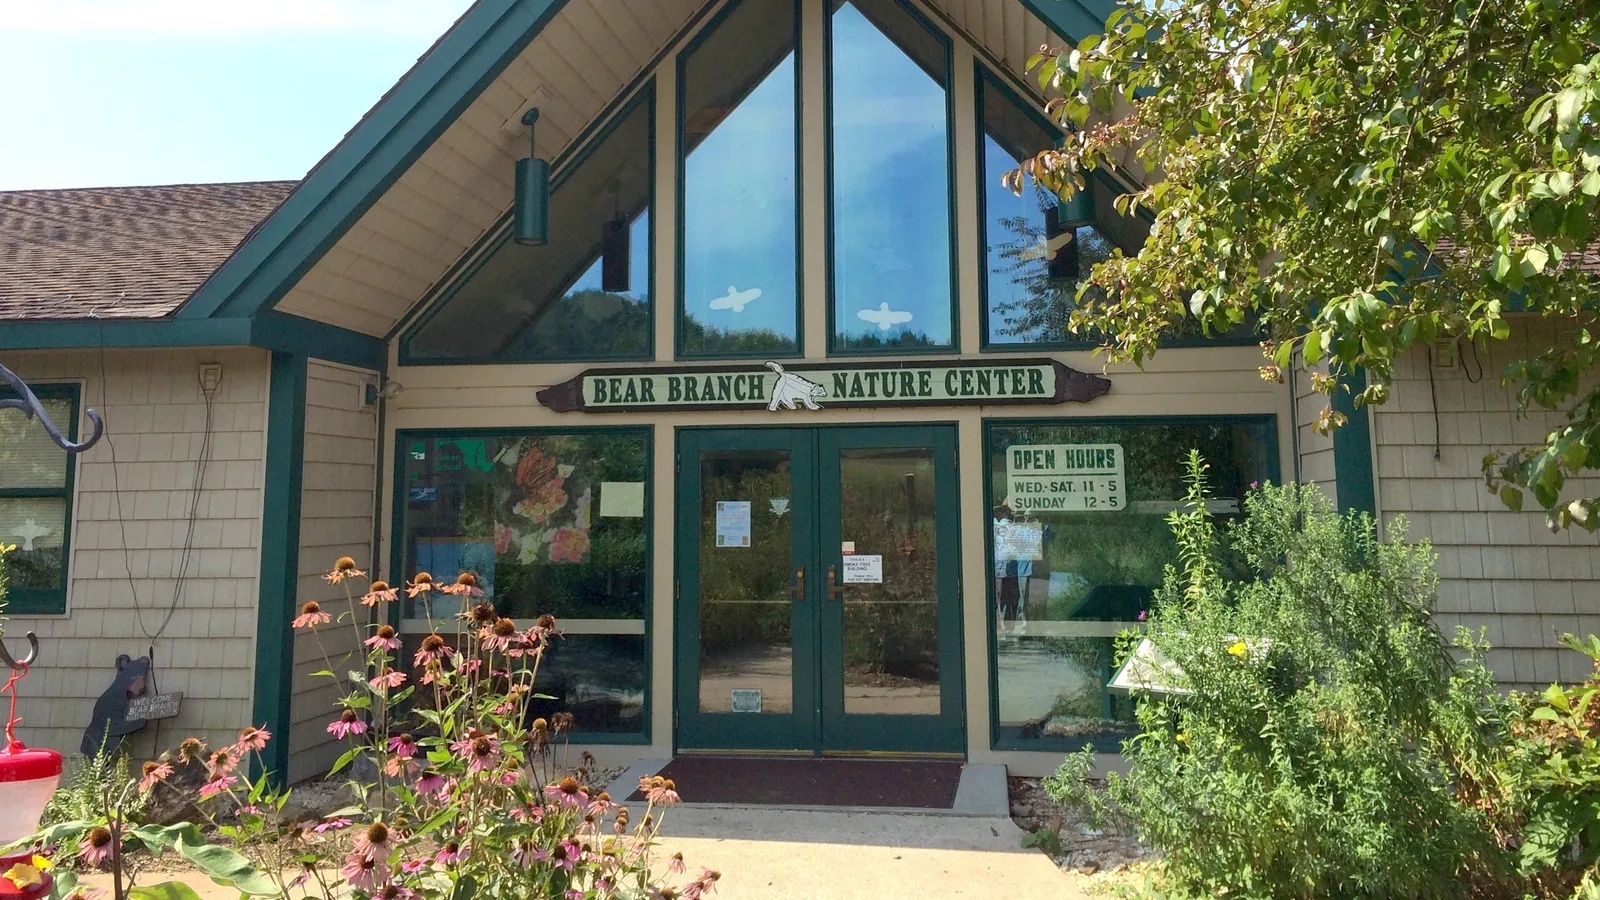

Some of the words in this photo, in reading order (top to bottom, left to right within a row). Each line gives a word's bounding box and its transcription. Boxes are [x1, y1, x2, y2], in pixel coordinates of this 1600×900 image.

[593, 377, 655, 403] BEAR
[667, 374, 765, 402] BRANCH
[832, 370, 932, 399] NATURE
[945, 368, 1045, 396] CENTER
[1013, 449, 1055, 470] OPEN
[1066, 448, 1116, 469] HOURS
[1083, 481, 1094, 492] 11
[1108, 480, 1117, 491] 5
[1014, 497, 1066, 509] SUNDAY
[1084, 497, 1097, 508] 12
[1109, 496, 1118, 507] 5
[133, 693, 173, 706] WELCOME
[128, 705, 148, 715] BEAR
